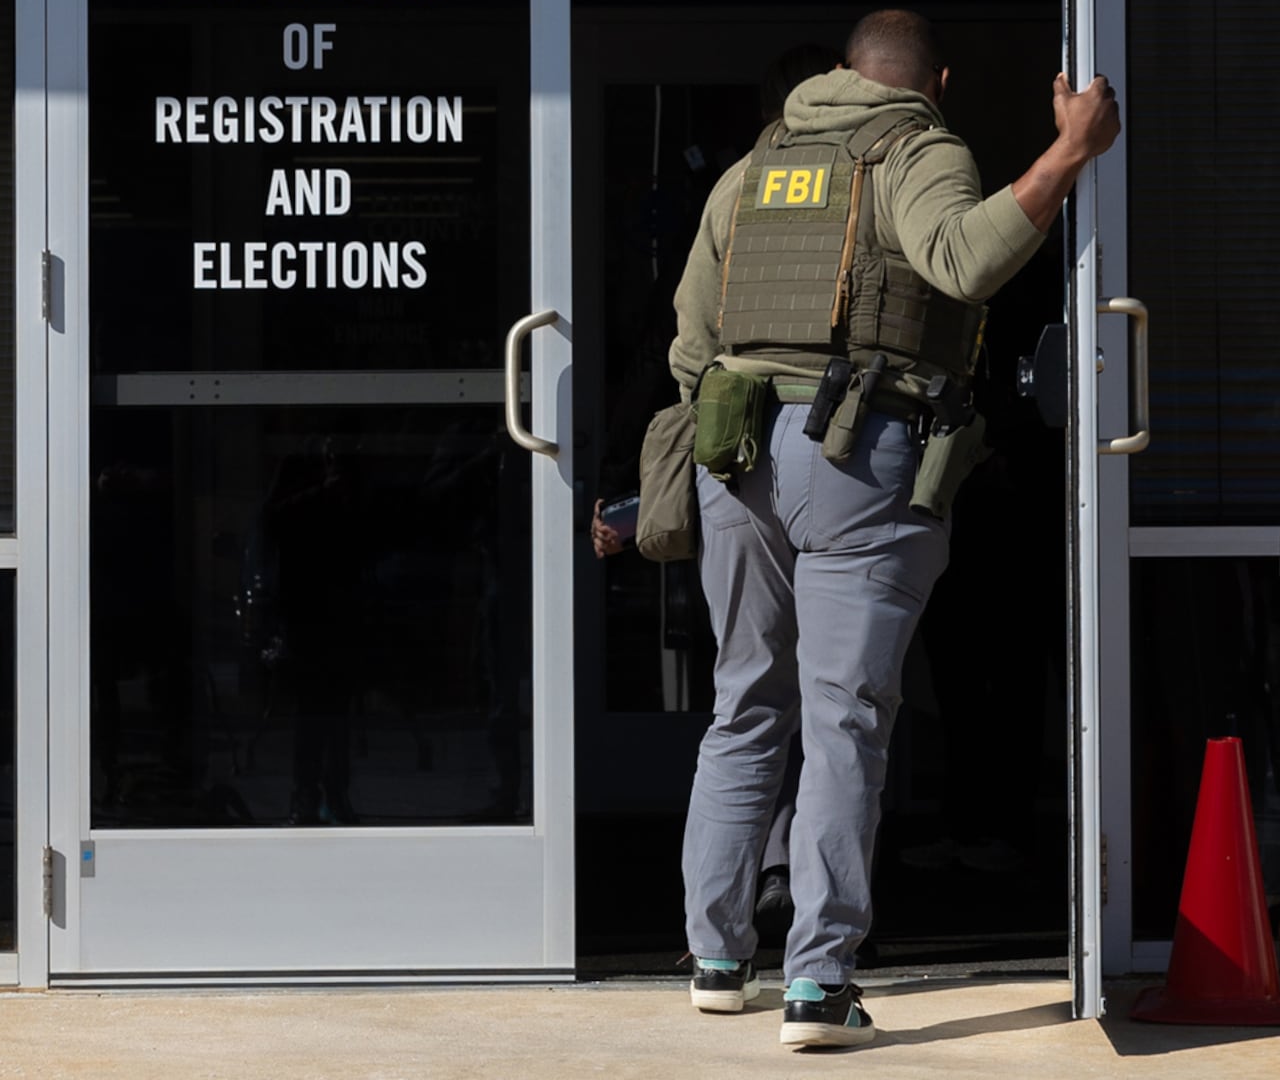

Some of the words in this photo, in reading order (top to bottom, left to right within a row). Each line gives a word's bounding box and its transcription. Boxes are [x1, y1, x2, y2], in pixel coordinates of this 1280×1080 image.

[283, 23, 337, 70] OF
[155, 95, 463, 144] REGISTRATION
[265, 168, 352, 216] AND
[762, 168, 825, 205] FBI
[193, 240, 428, 290] ELECTIONS
